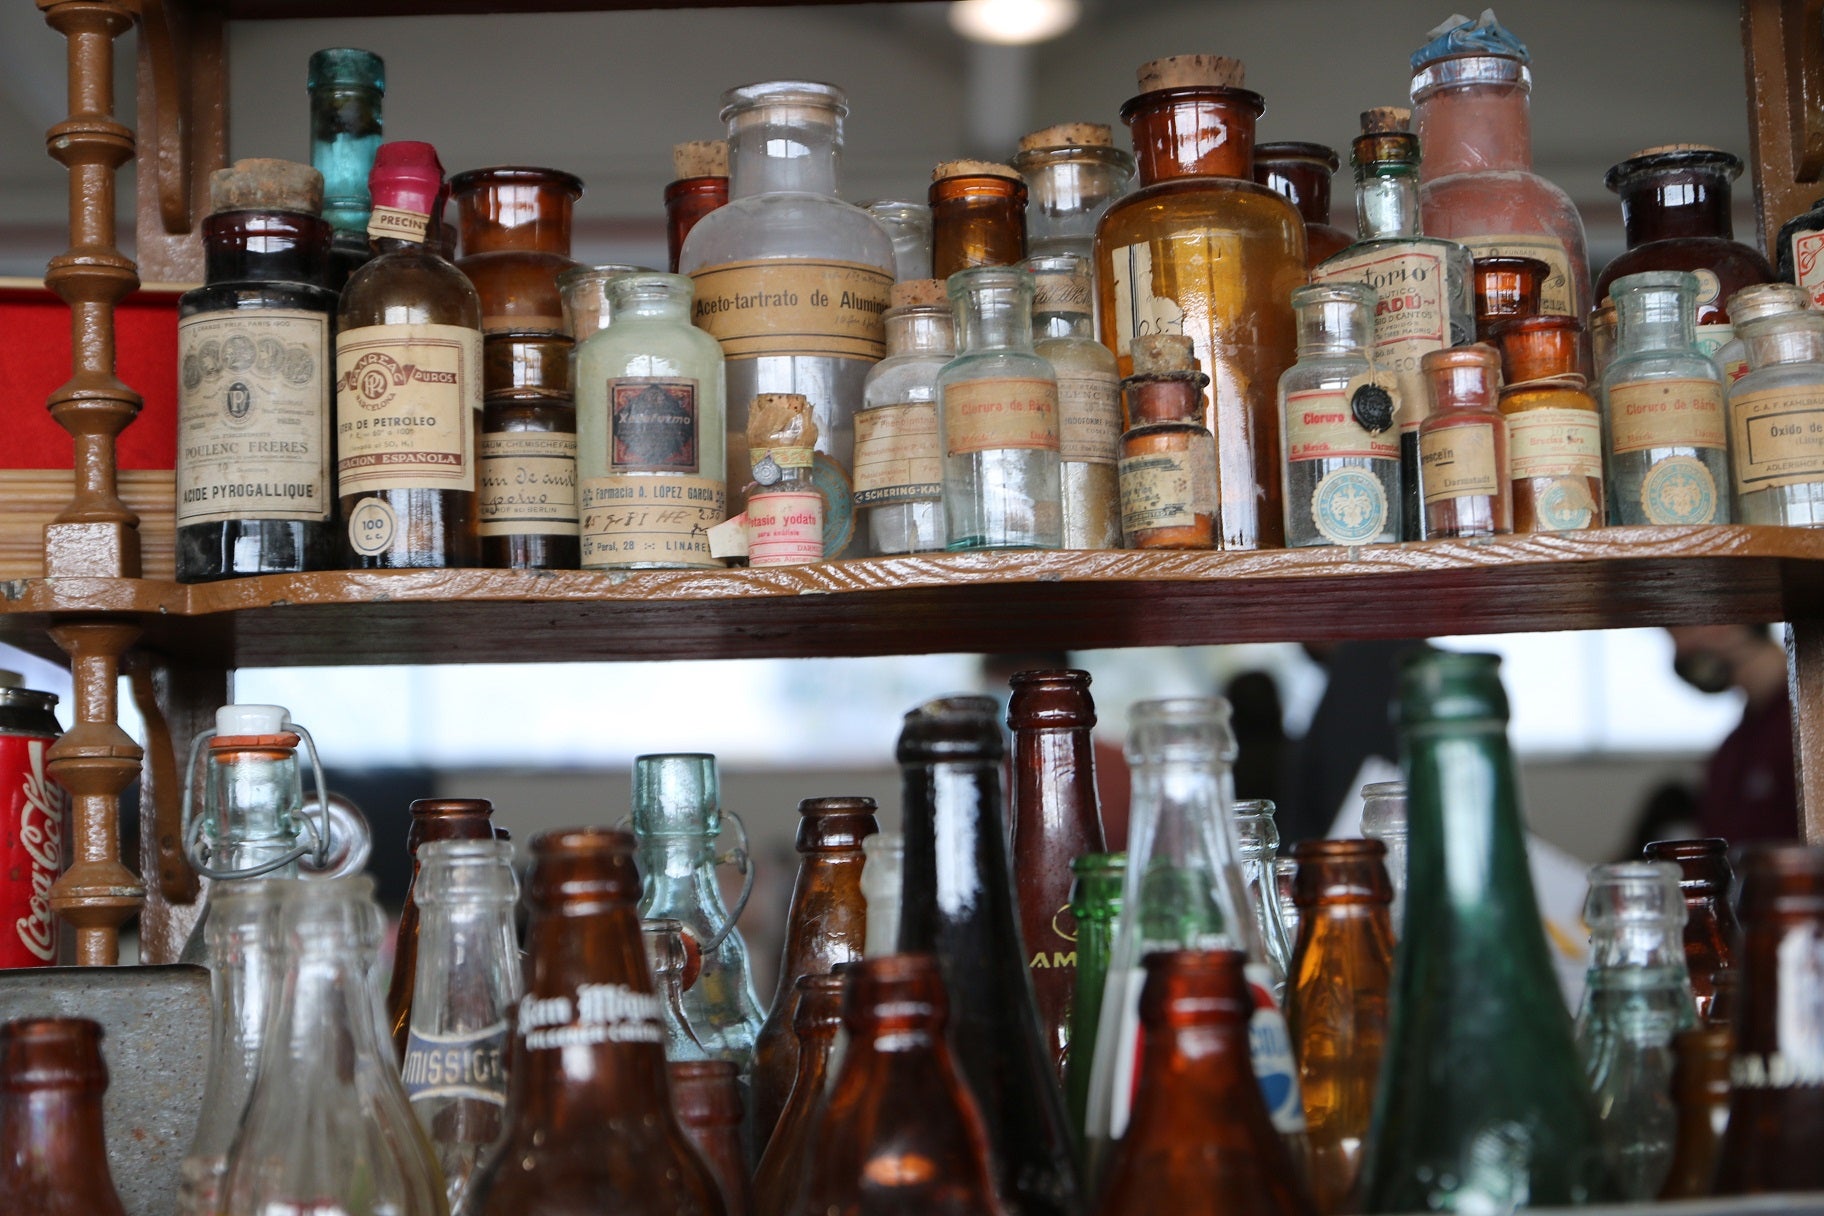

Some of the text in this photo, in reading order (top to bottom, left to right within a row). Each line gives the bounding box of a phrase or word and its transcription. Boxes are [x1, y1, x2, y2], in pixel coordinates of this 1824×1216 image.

[695, 289, 798, 318] Aceto-tartrato
[810, 289, 829, 307] de
[414, 370, 454, 384] PUROS
[1010, 399, 1023, 412] de
[1626, 403, 1667, 416] Cloruro
[1674, 400, 1687, 410] de
[356, 419, 368, 430] DE
[373, 416, 437, 428] PETROLEO
[1303, 412, 1345, 425] Cloruro
[1770, 422, 1823, 438] Óxido de
[185, 442, 240, 460] POULENC
[1292, 444, 1301, 454] E.
[382, 451, 457, 465] ESPAÑOLA
[1443, 475, 1490, 488] Darmstadt
[183, 483, 314, 504] ACIDE PYROGALLIQUE
[596, 485, 714, 501] Farmacia A. LÓPEZ GARCÍA
[527, 506, 558, 514] BERLIN
[362, 519, 384, 531] 100
[623, 540, 635, 551] 28
